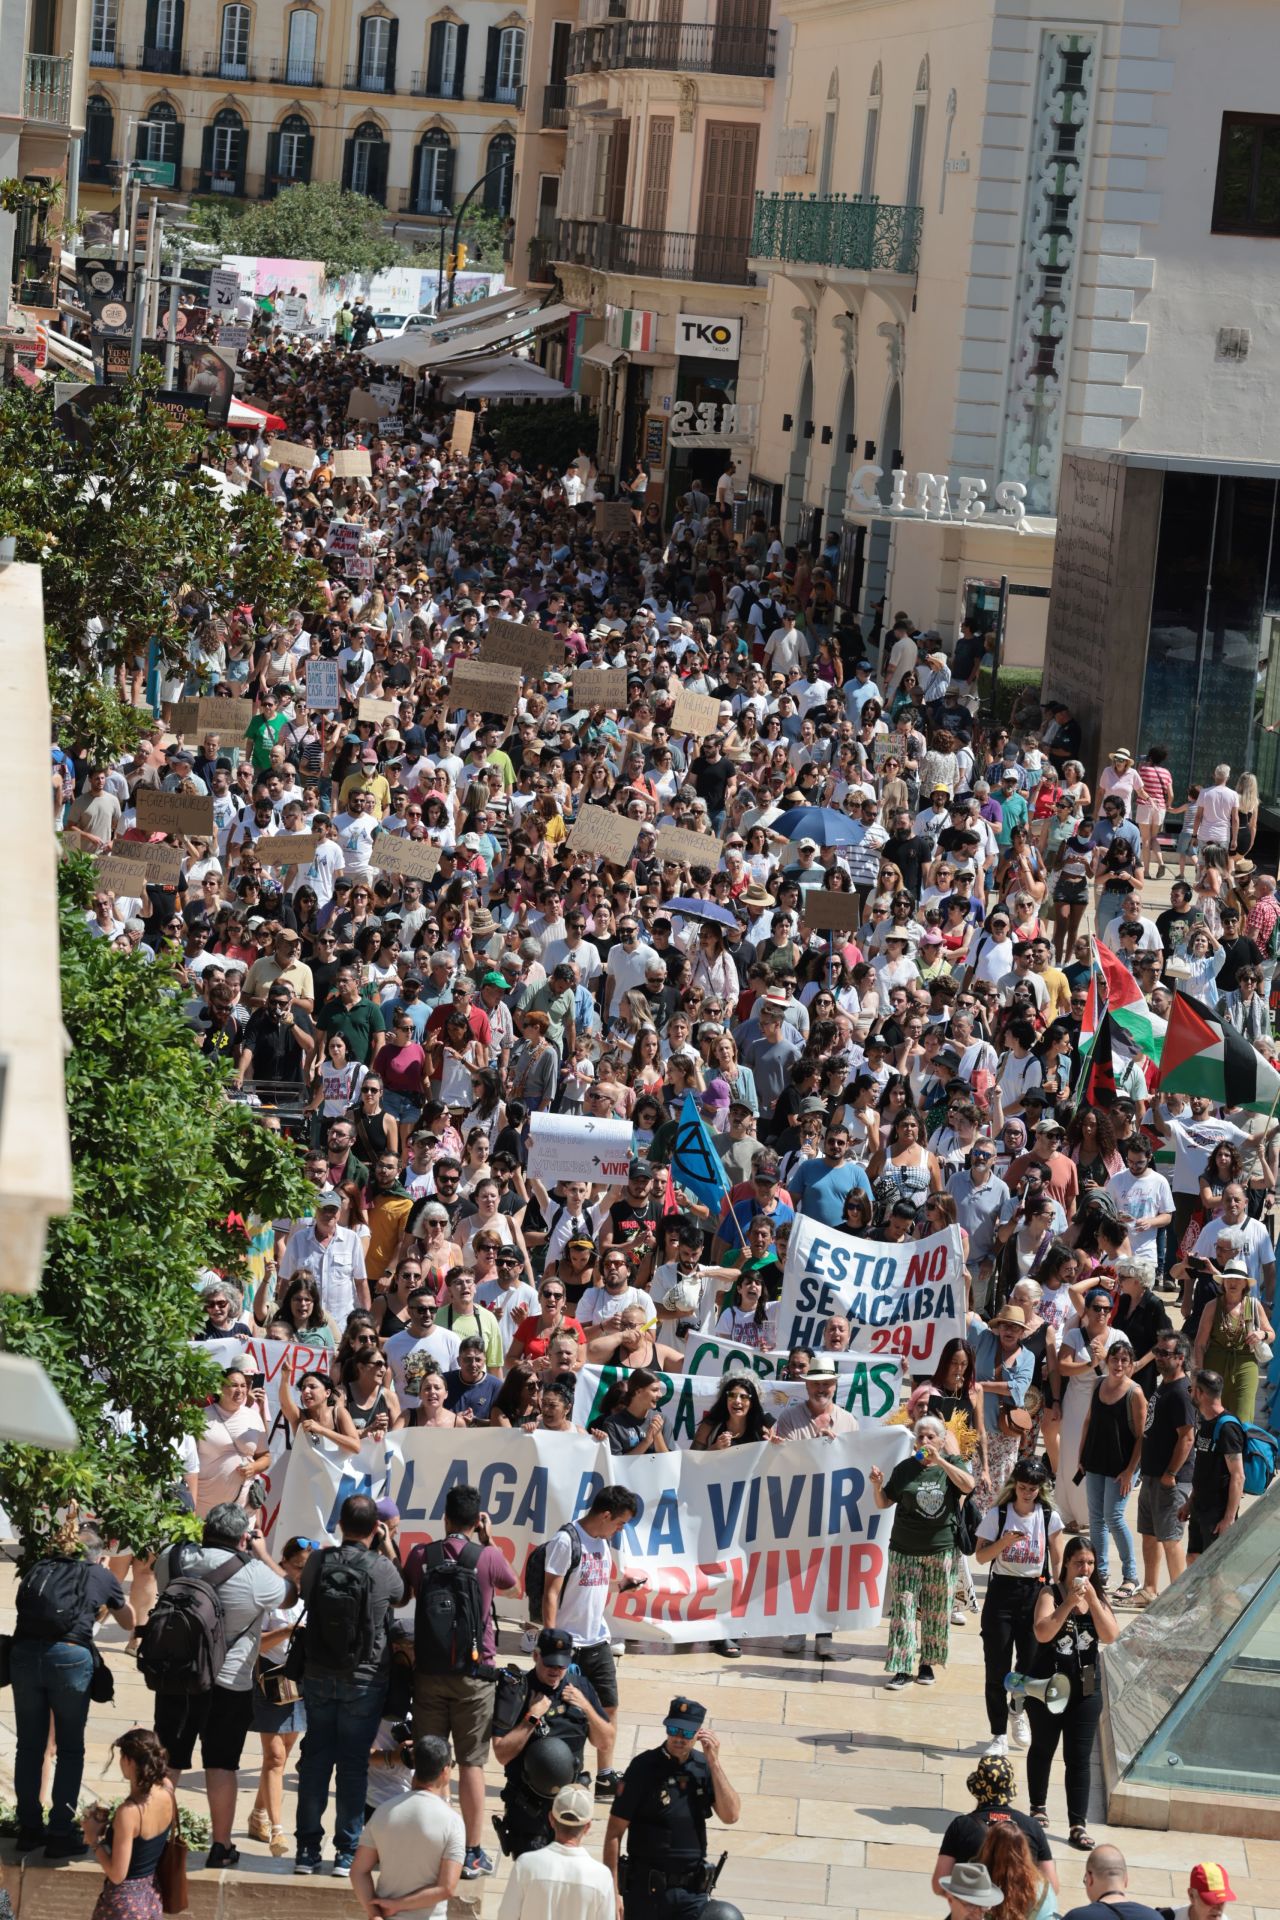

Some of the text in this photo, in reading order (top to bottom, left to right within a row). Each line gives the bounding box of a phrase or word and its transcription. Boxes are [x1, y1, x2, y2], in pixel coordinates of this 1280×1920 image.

[682, 322, 731, 345] TKO
[852, 465, 1026, 524] CINES
[580, 806, 618, 827] DIGITAL
[601, 1162, 630, 1177] VIVIR
[804, 1238, 948, 1291] ESTO NO
[796, 1277, 955, 1327] SE ACABA
[870, 1322, 935, 1360] 29J
[326, 1450, 881, 1556] MLAGA PRA VIVIR,
